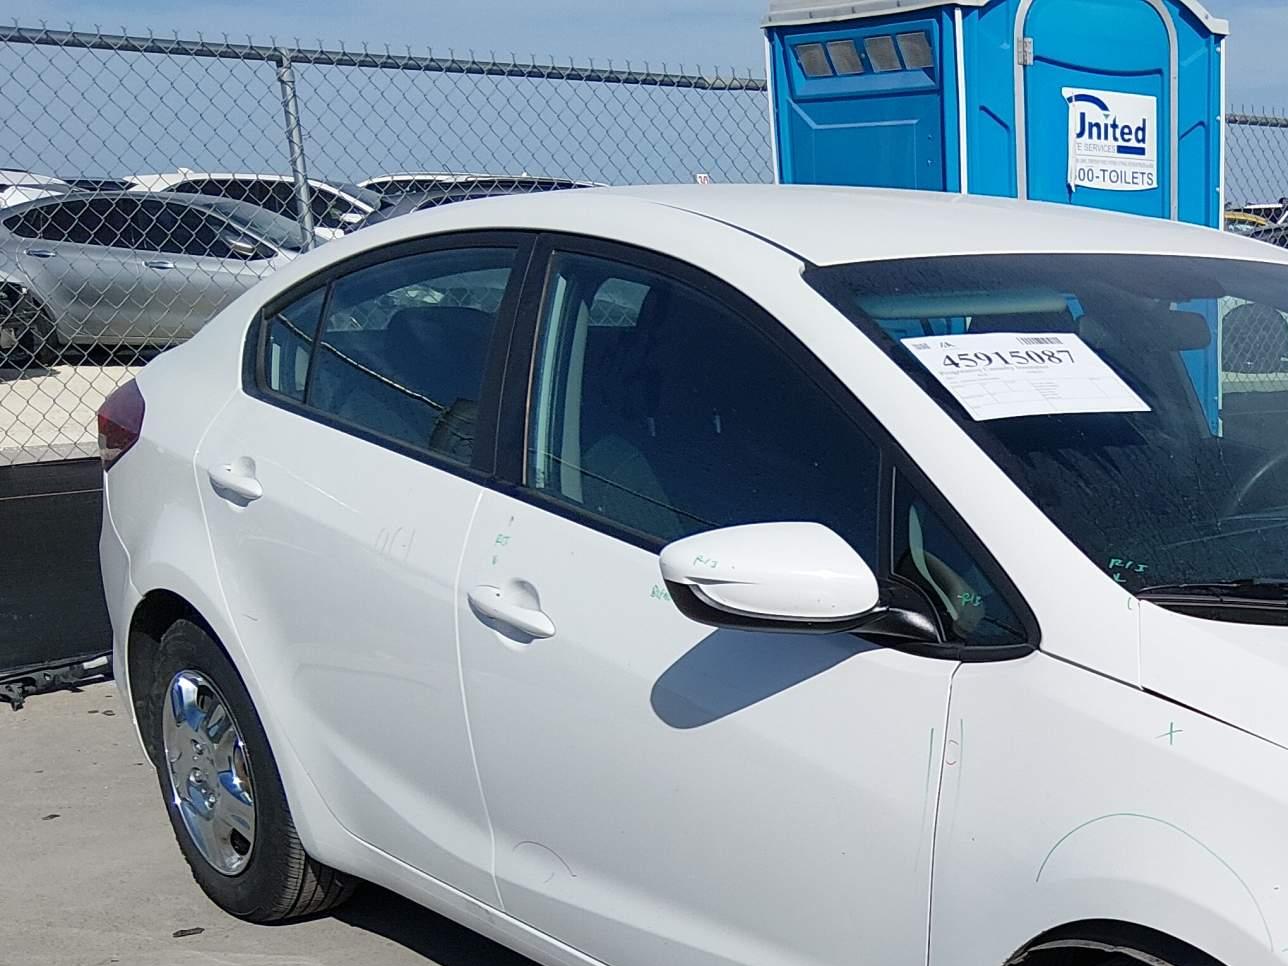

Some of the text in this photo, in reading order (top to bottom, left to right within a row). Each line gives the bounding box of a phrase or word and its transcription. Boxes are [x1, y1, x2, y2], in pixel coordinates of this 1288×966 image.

[1083, 143, 1116, 154] SERVICES
[1074, 167, 1154, 186] 00-TOILETS
[943, 349, 1076, 369] 45915087
